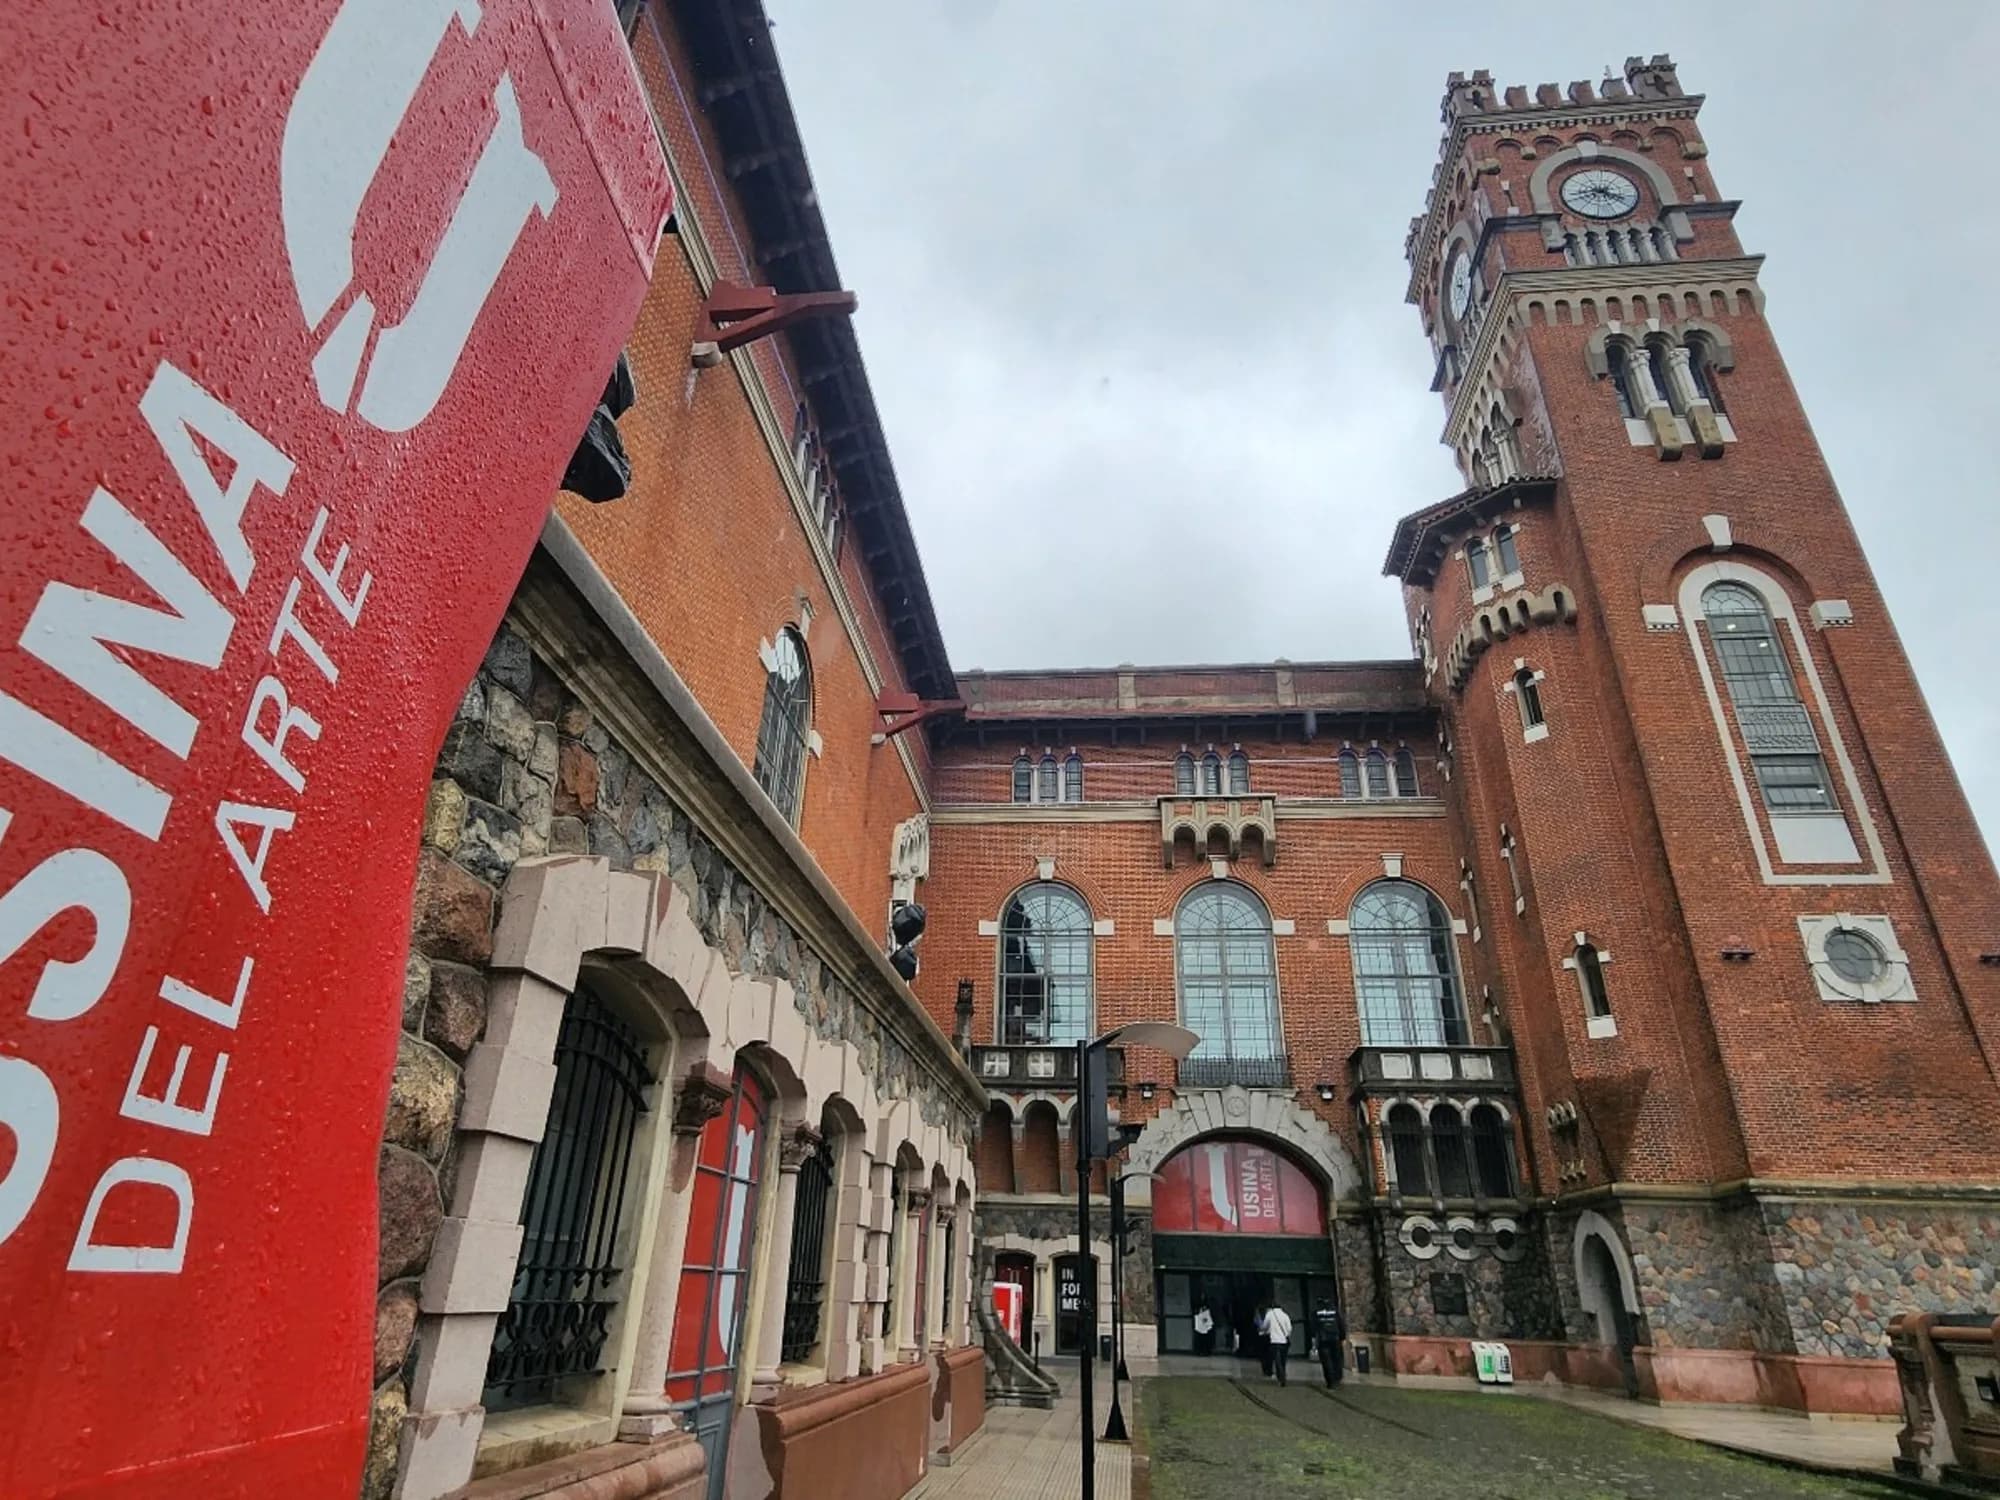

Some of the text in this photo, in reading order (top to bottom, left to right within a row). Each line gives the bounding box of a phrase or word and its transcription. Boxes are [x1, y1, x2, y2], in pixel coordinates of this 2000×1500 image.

[66, 505, 373, 1274] DEL ARTE
[1241, 1158, 1261, 1217] USINA
[1259, 1159, 1276, 1217] DEL ARTE
[1061, 1268, 1074, 1280] IN
[1061, 1298, 1080, 1310] ME
